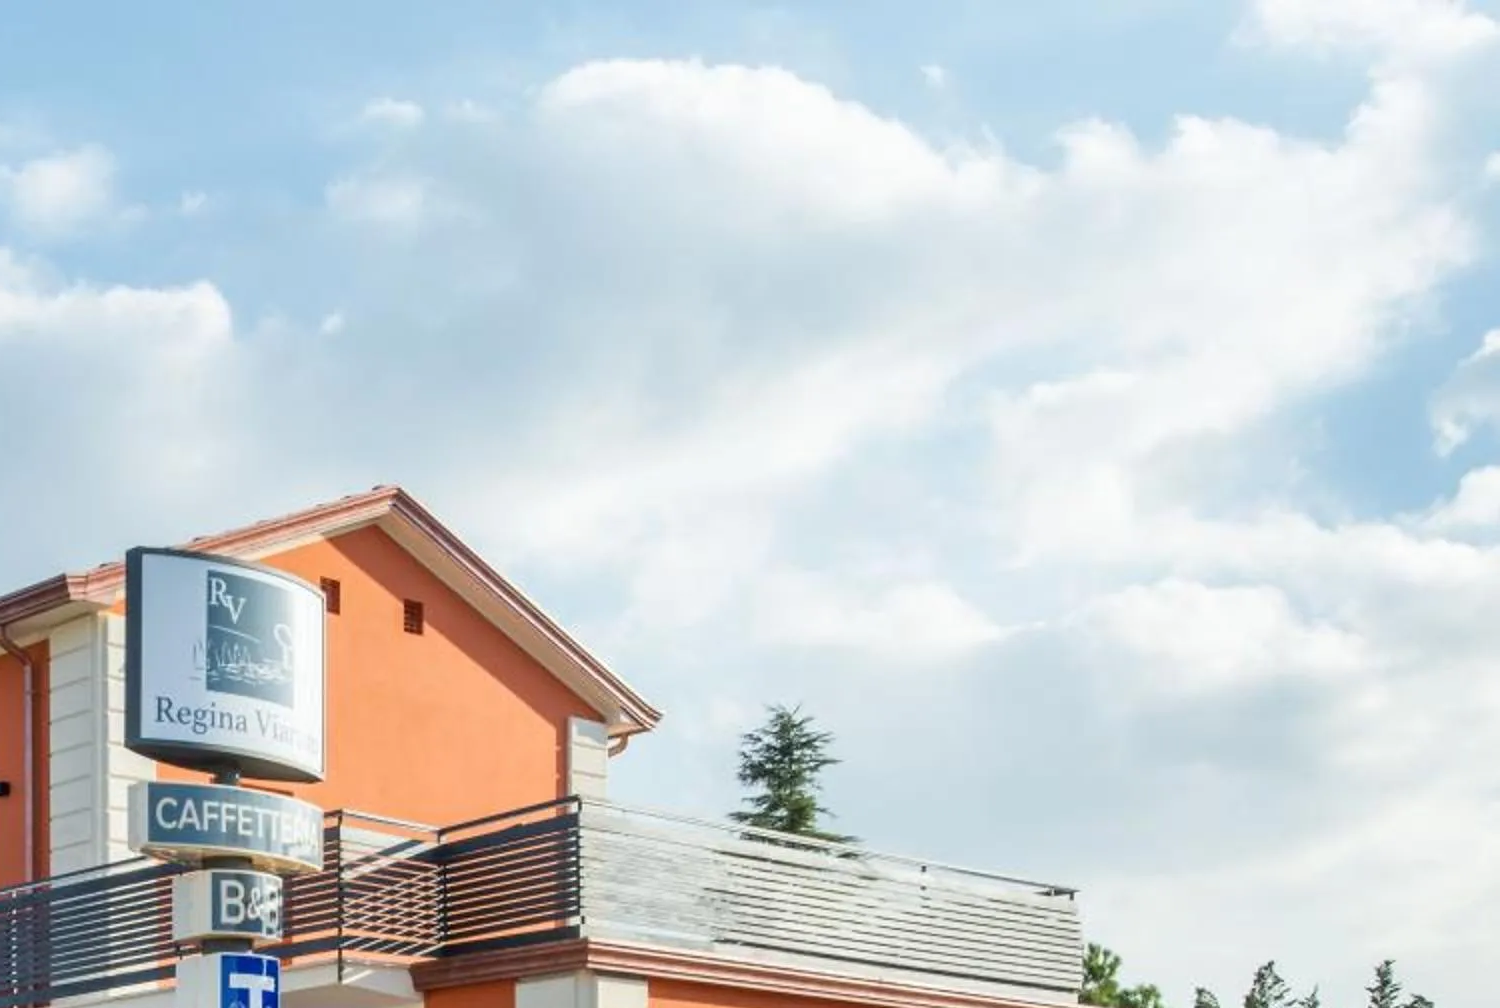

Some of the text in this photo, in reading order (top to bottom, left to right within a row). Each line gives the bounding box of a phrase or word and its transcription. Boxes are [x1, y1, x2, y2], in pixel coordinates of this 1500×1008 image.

[155, 696, 319, 755] Regina Viar
[219, 878, 279, 929] B&B
